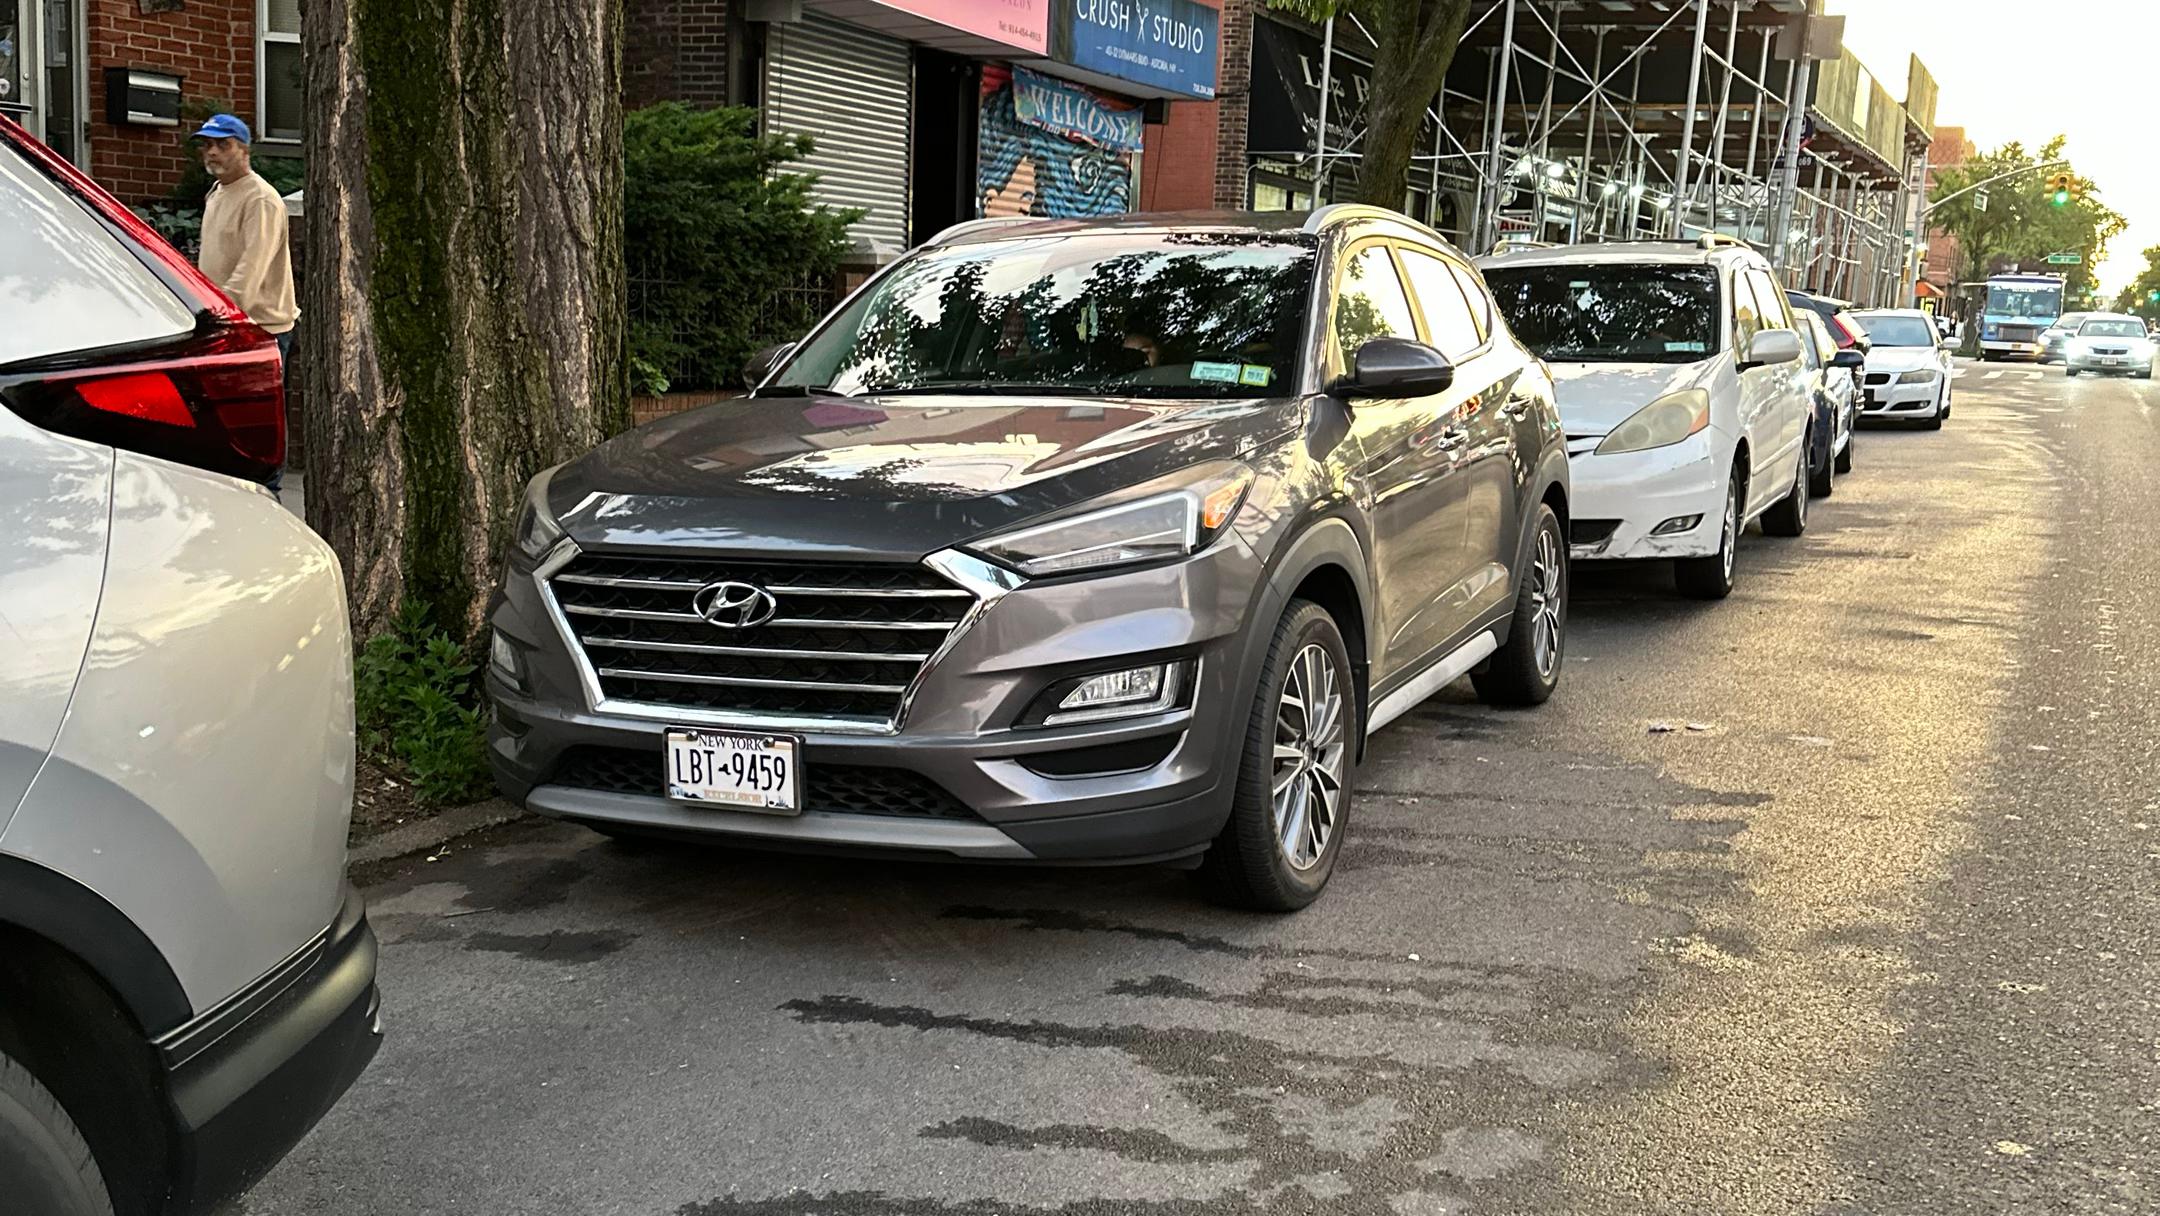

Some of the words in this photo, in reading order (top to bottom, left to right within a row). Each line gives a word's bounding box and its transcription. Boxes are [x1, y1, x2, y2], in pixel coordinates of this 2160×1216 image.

[1077, 0, 1130, 33] CRUSH
[1153, 14, 1204, 54] STUDIO
[1030, 84, 1130, 144] WELCOME
[1499, 216, 1531, 231] ATM
[698, 733, 726, 748] NEW
[730, 736, 764, 752] YORK
